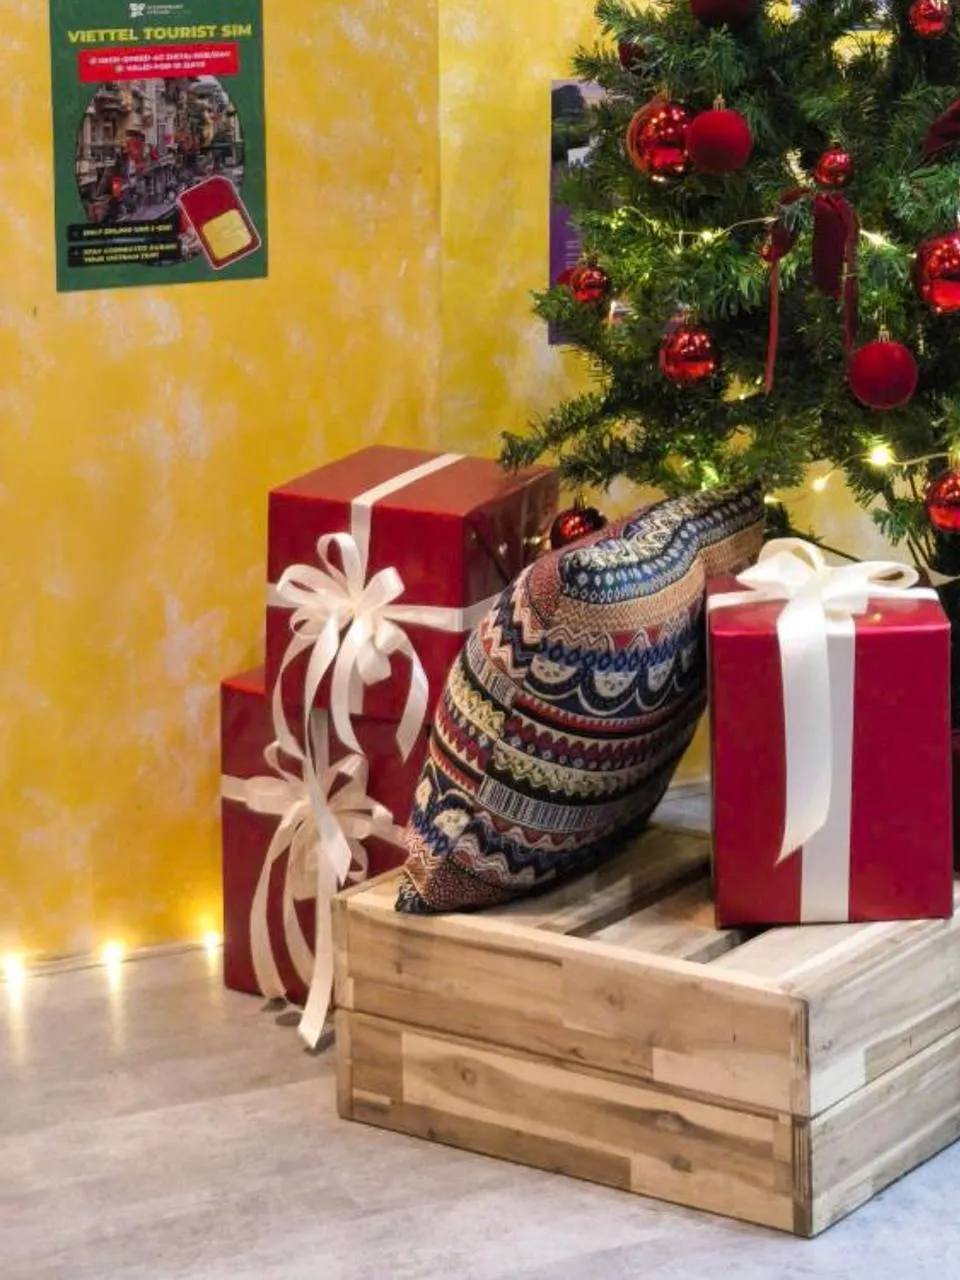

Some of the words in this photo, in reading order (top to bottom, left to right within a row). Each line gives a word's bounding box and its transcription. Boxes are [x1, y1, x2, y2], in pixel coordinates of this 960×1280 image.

[67, 27, 138, 43] VIETTEL
[142, 24, 217, 41] TOURIST
[221, 23, 252, 38] SIM
